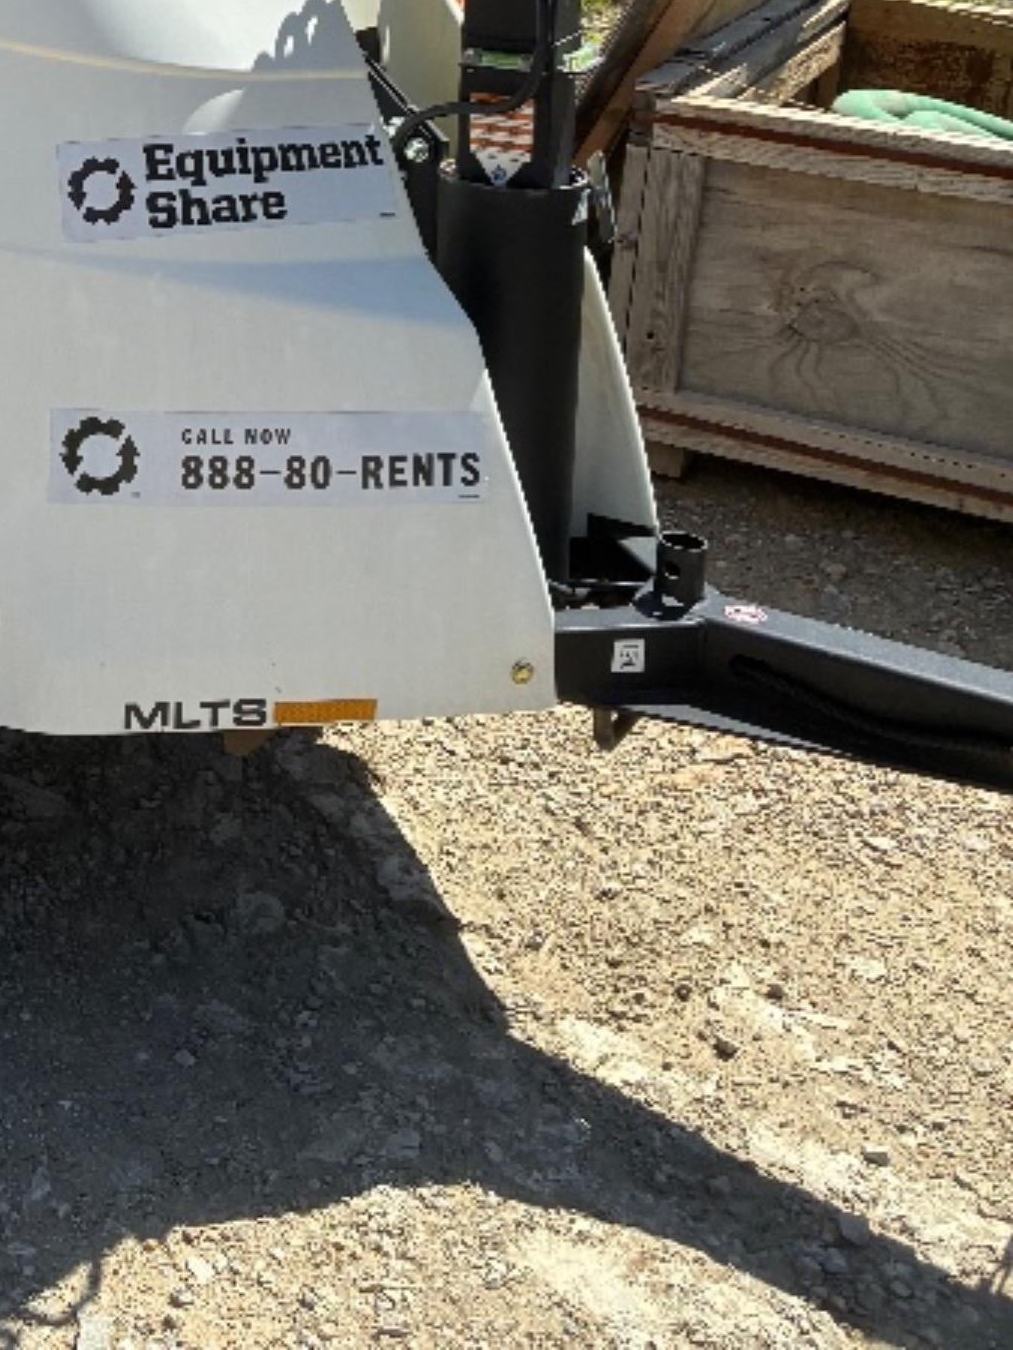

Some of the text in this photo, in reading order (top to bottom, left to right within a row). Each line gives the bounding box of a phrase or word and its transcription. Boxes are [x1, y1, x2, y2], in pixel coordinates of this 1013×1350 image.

[143, 135, 384, 186] Equipment
[145, 188, 288, 229] Share
[181, 427, 292, 446] CALL NOW
[180, 452, 481, 490] 888-80-RENTS
[124, 699, 267, 730] MLTS
